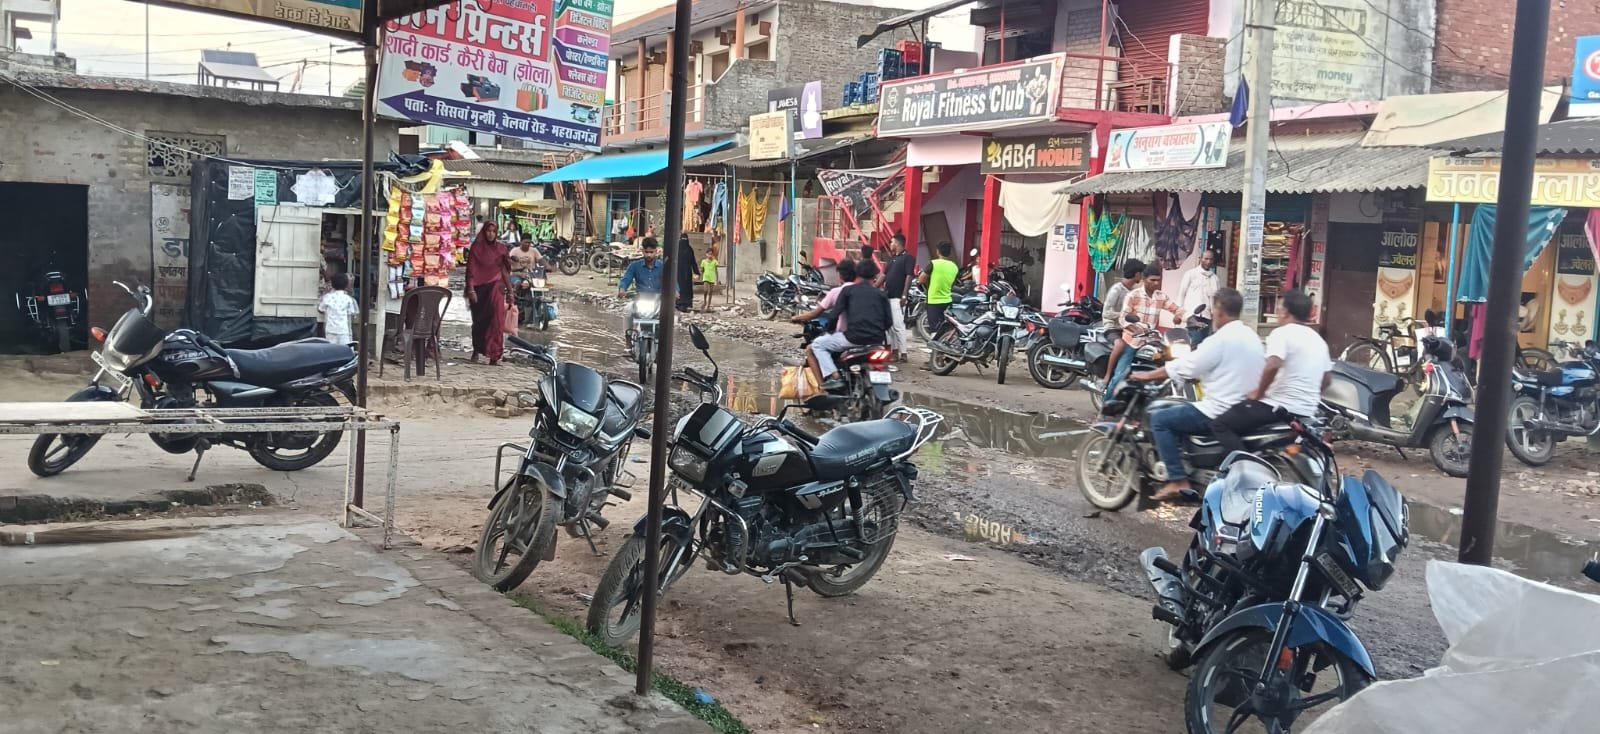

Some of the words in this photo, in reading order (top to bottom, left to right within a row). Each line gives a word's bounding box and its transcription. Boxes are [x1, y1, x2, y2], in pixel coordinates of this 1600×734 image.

[456, 0, 547, 57] प्रिन्टर्स
[386, 34, 417, 58] शादी
[457, 47, 484, 71] कैरी
[488, 51, 508, 76] बैग
[513, 59, 553, 89] (झोला)
[1317, 70, 1353, 85] money
[902, 95, 935, 126] Royal
[937, 89, 986, 117] Fitness
[989, 82, 1025, 113] Club
[435, 102, 469, 121] सिसवां
[501, 113, 529, 131] बेलवां
[551, 124, 597, 145] महराजगंज
[988, 141, 1035, 170] BABA
[1037, 147, 1082, 167] MOBILE
[826, 172, 850, 193] Royal
[1380, 227, 1417, 248] आलोक
